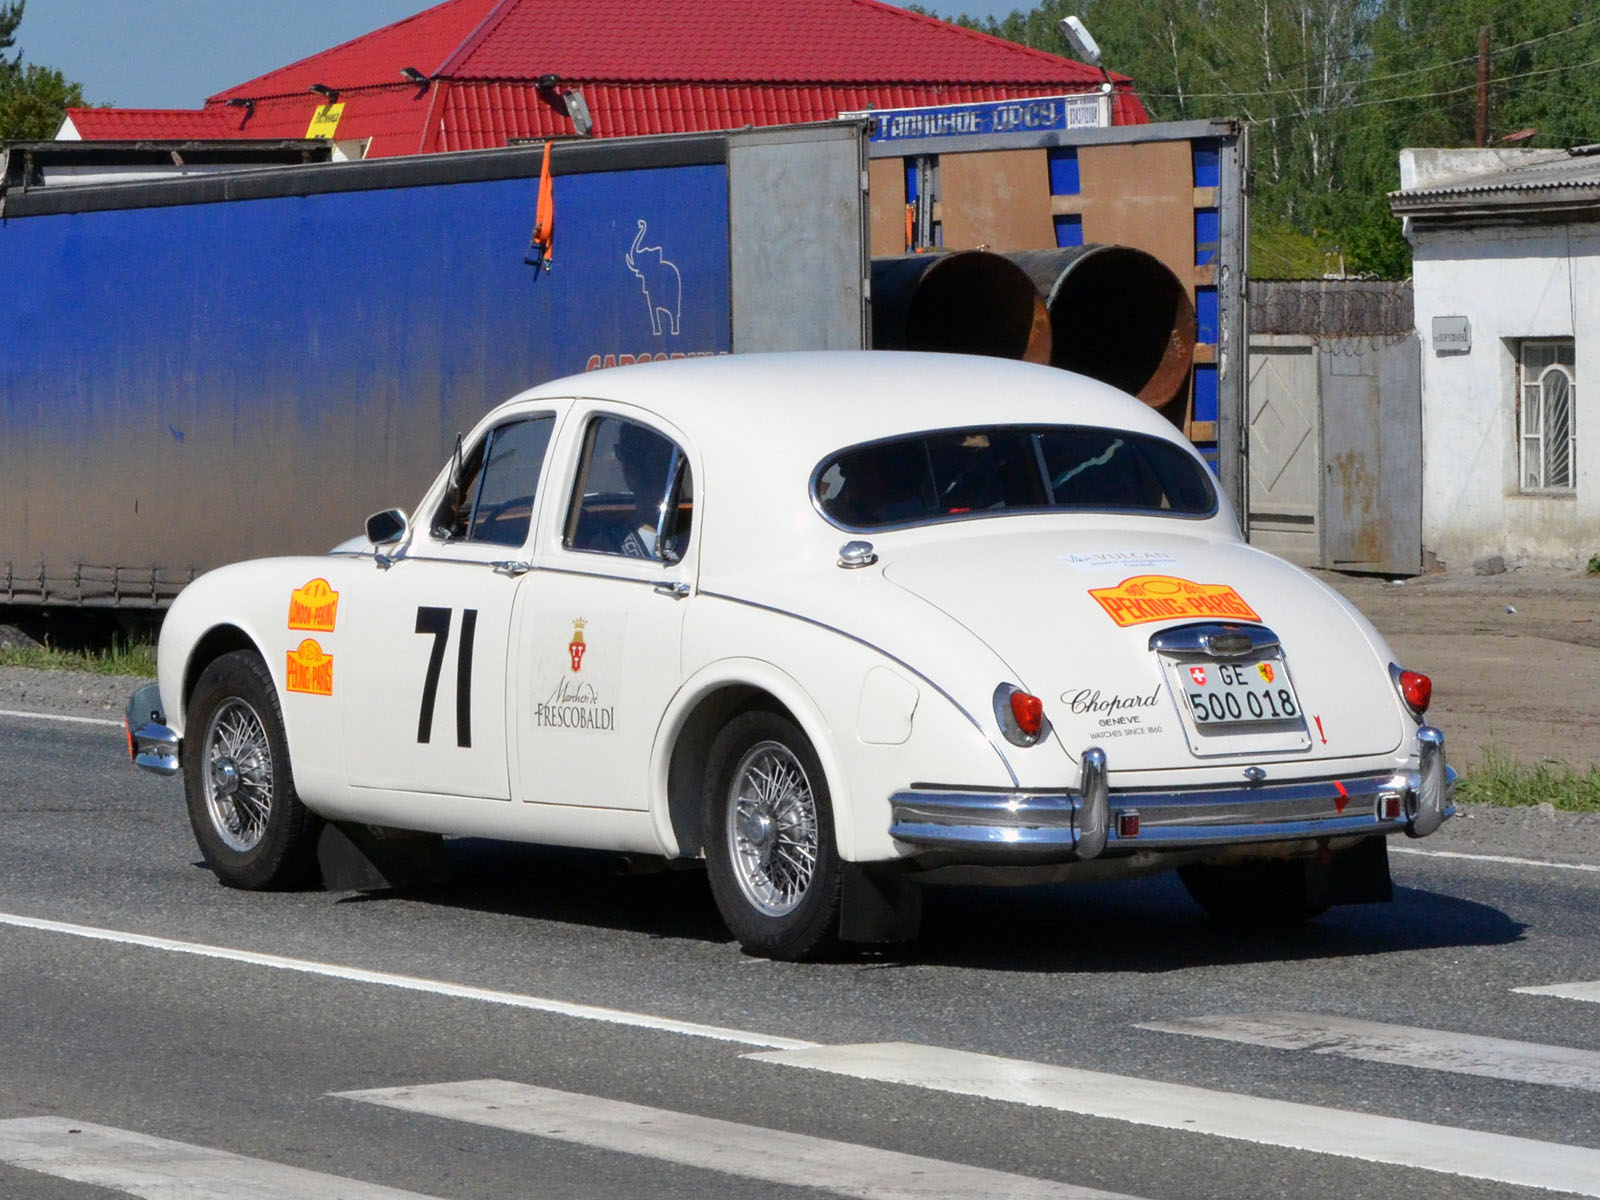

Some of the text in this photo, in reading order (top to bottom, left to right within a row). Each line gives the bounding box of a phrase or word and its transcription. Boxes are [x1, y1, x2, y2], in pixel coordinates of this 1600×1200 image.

[1102, 591, 1252, 621] PEKING PARIS
[287, 655, 333, 692] PEKING PARIS
[415, 606, 478, 748] 71
[1219, 664, 1248, 685] GE
[1060, 683, 1161, 717] Chopard
[1190, 689, 1296, 721] 500 018
[534, 703, 614, 731] FRESCOBALDI
[1090, 725, 1163, 740] WATCHES SINCE 1860
